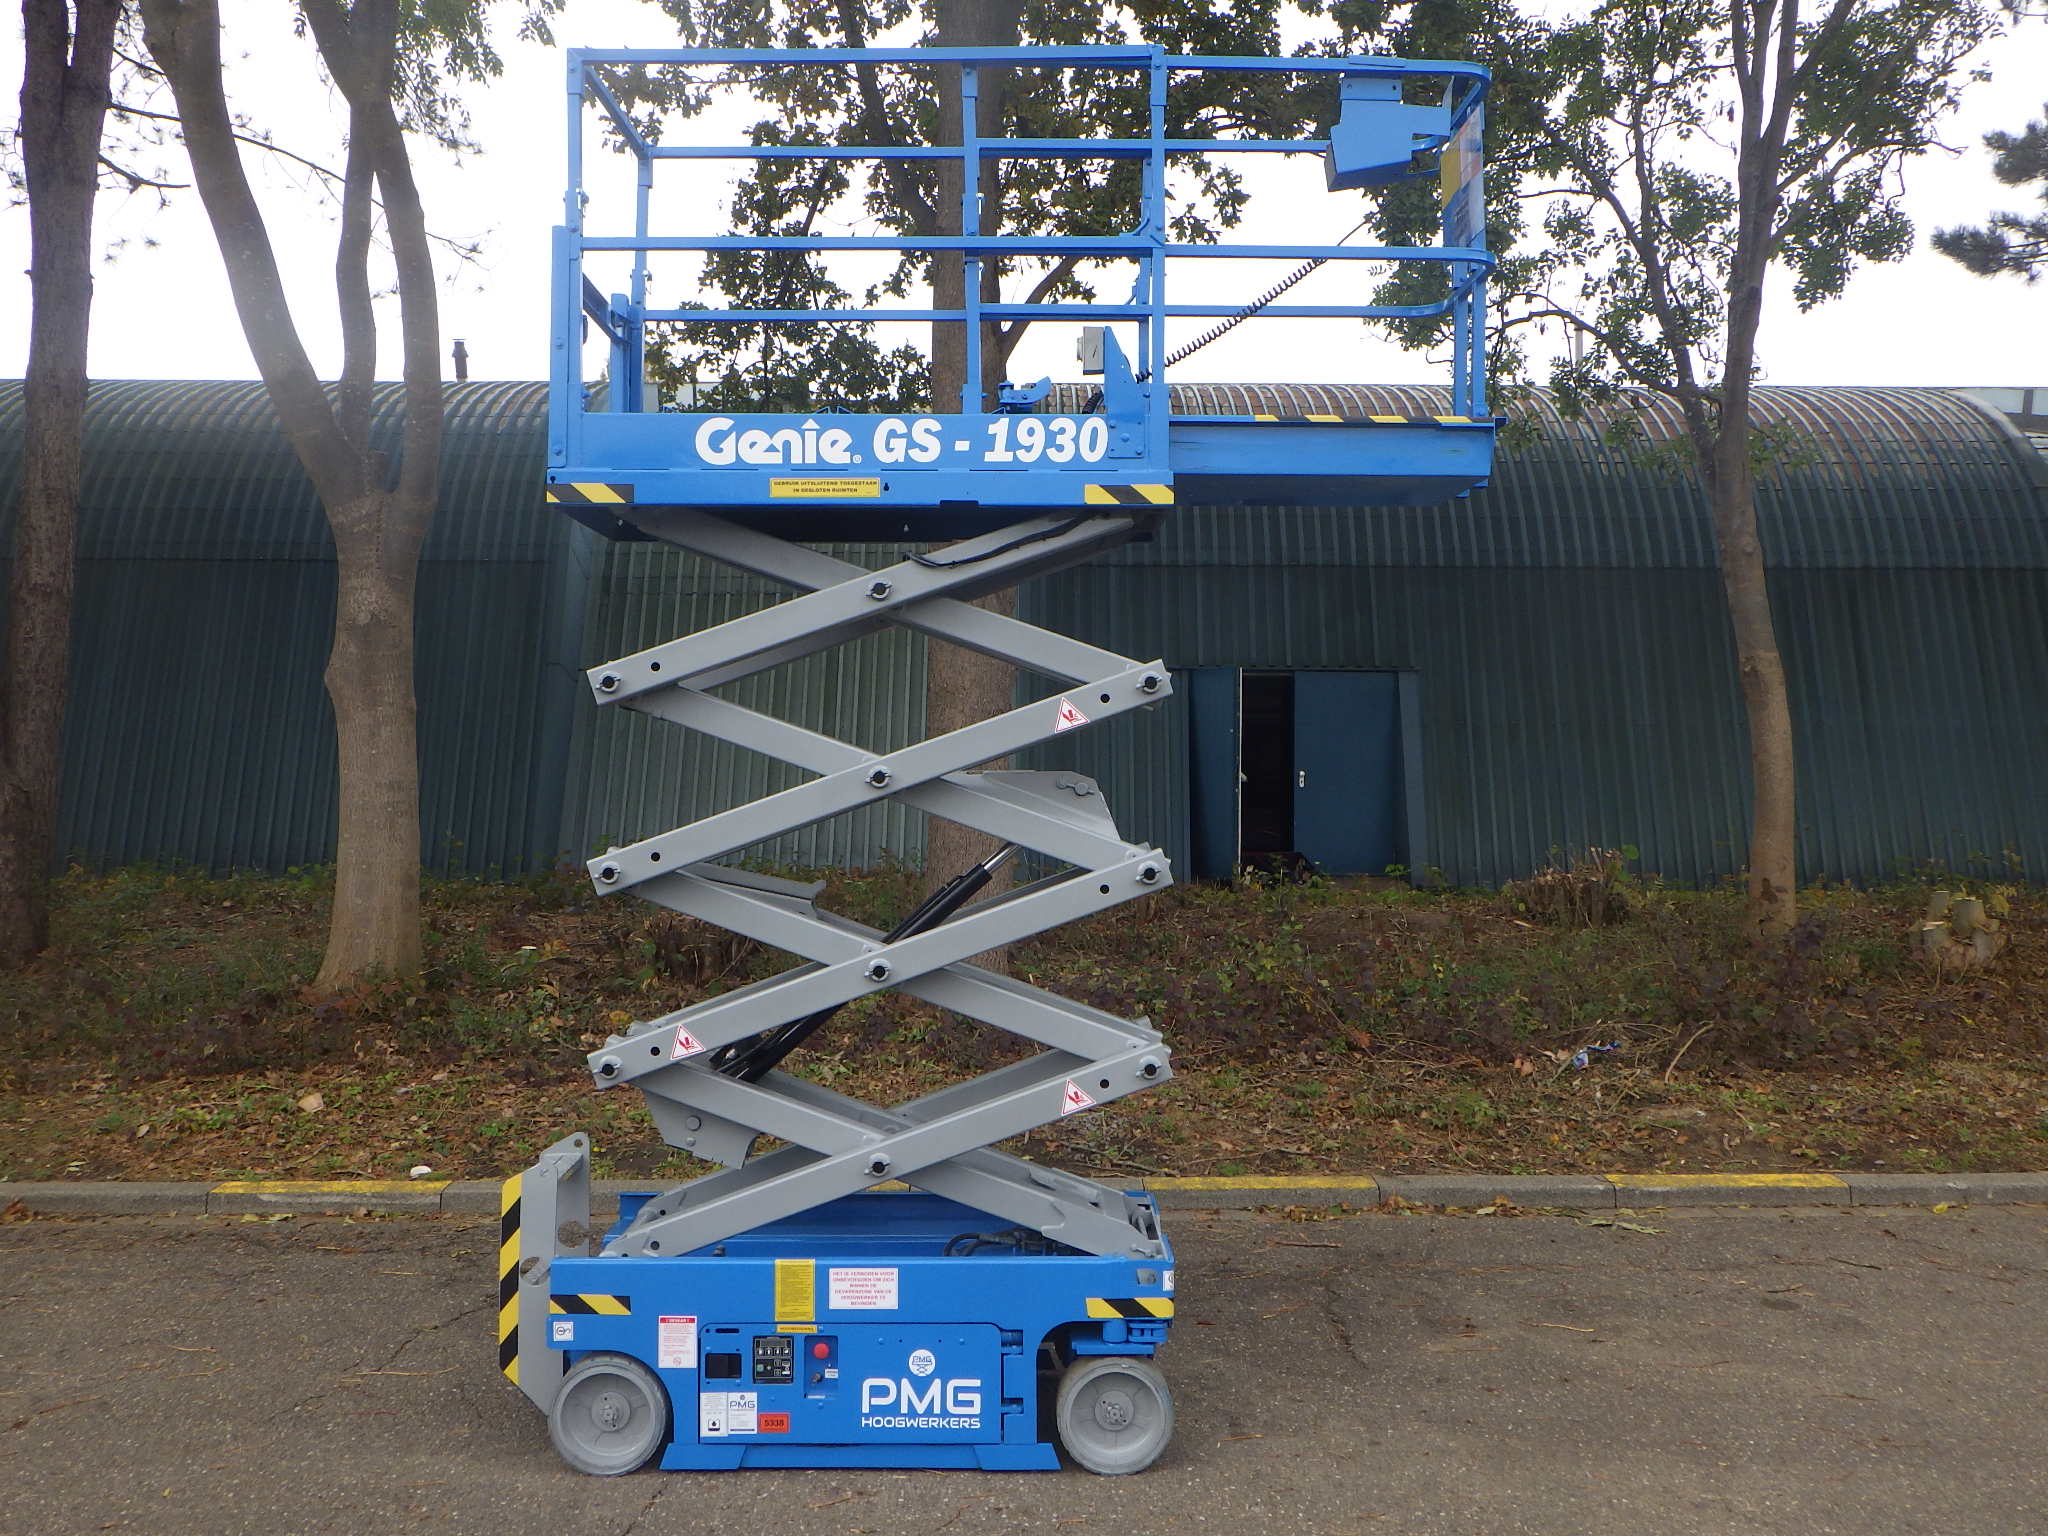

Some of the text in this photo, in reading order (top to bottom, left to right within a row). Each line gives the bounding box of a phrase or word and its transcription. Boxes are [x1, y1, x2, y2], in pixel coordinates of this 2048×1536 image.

[872, 417, 943, 465] GS
[983, 416, 1109, 464] 1930
[729, 1400, 756, 1409] PMG
[861, 1377, 982, 1415] PMG
[861, 1416, 982, 1429] HOOGWERKERS
